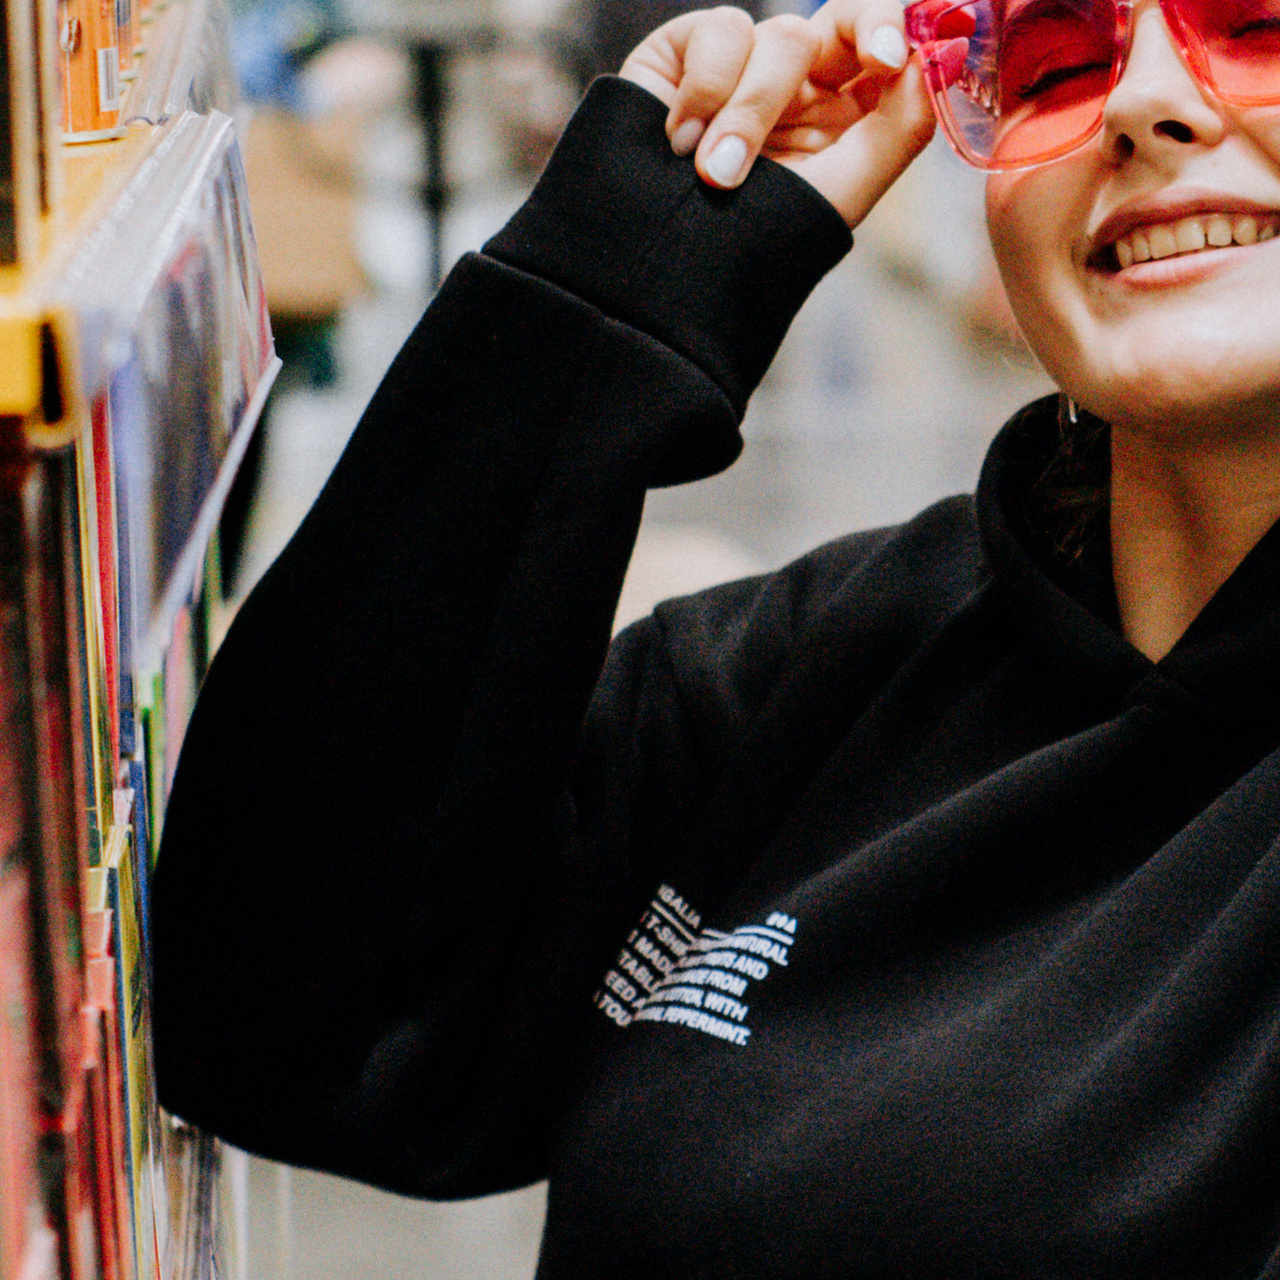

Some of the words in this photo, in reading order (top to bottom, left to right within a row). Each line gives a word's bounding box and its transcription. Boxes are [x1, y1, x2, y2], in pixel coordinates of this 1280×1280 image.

[732, 955, 769, 981] AND
[705, 969, 748, 997] FROM
[704, 992, 750, 1022] WITH
